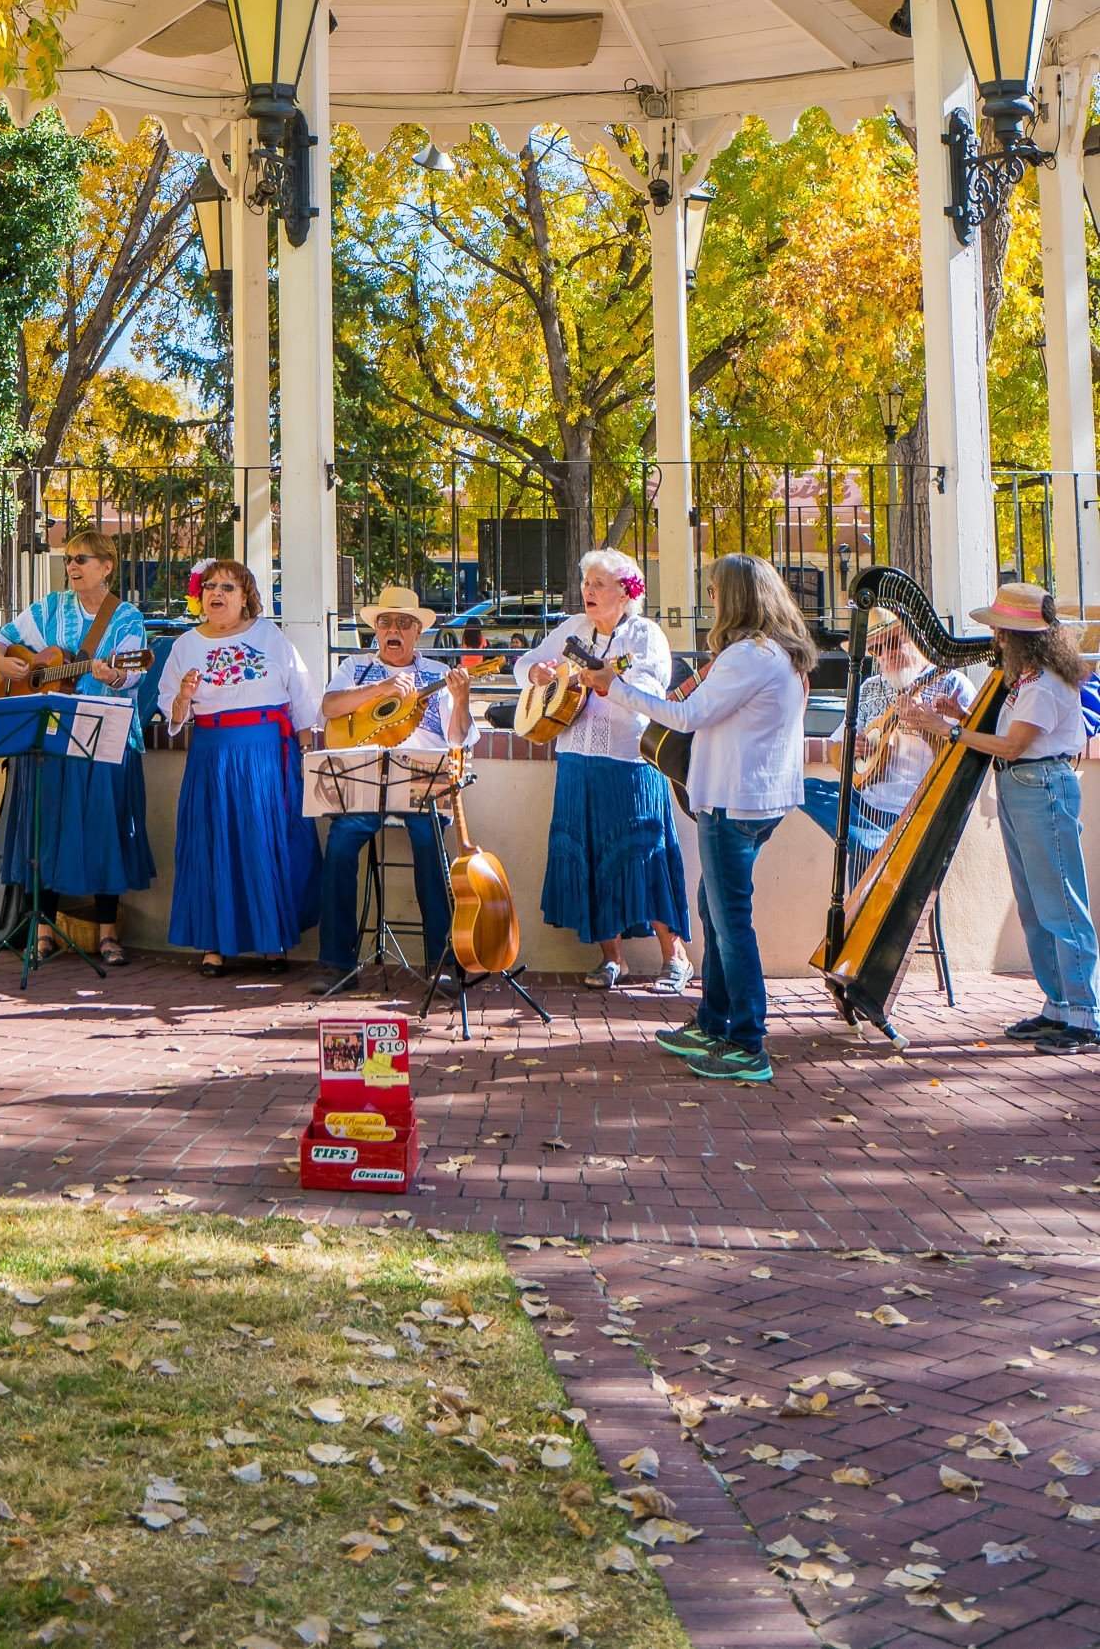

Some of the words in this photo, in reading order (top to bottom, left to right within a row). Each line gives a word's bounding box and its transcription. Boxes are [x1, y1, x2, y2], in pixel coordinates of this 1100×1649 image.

[367, 1024, 398, 1037] CD'S
[378, 1040, 405, 1052] $10
[326, 1114, 341, 1125] La
[343, 1114, 382, 1125] Rondalla
[346, 1126, 394, 1139] Albuquerque
